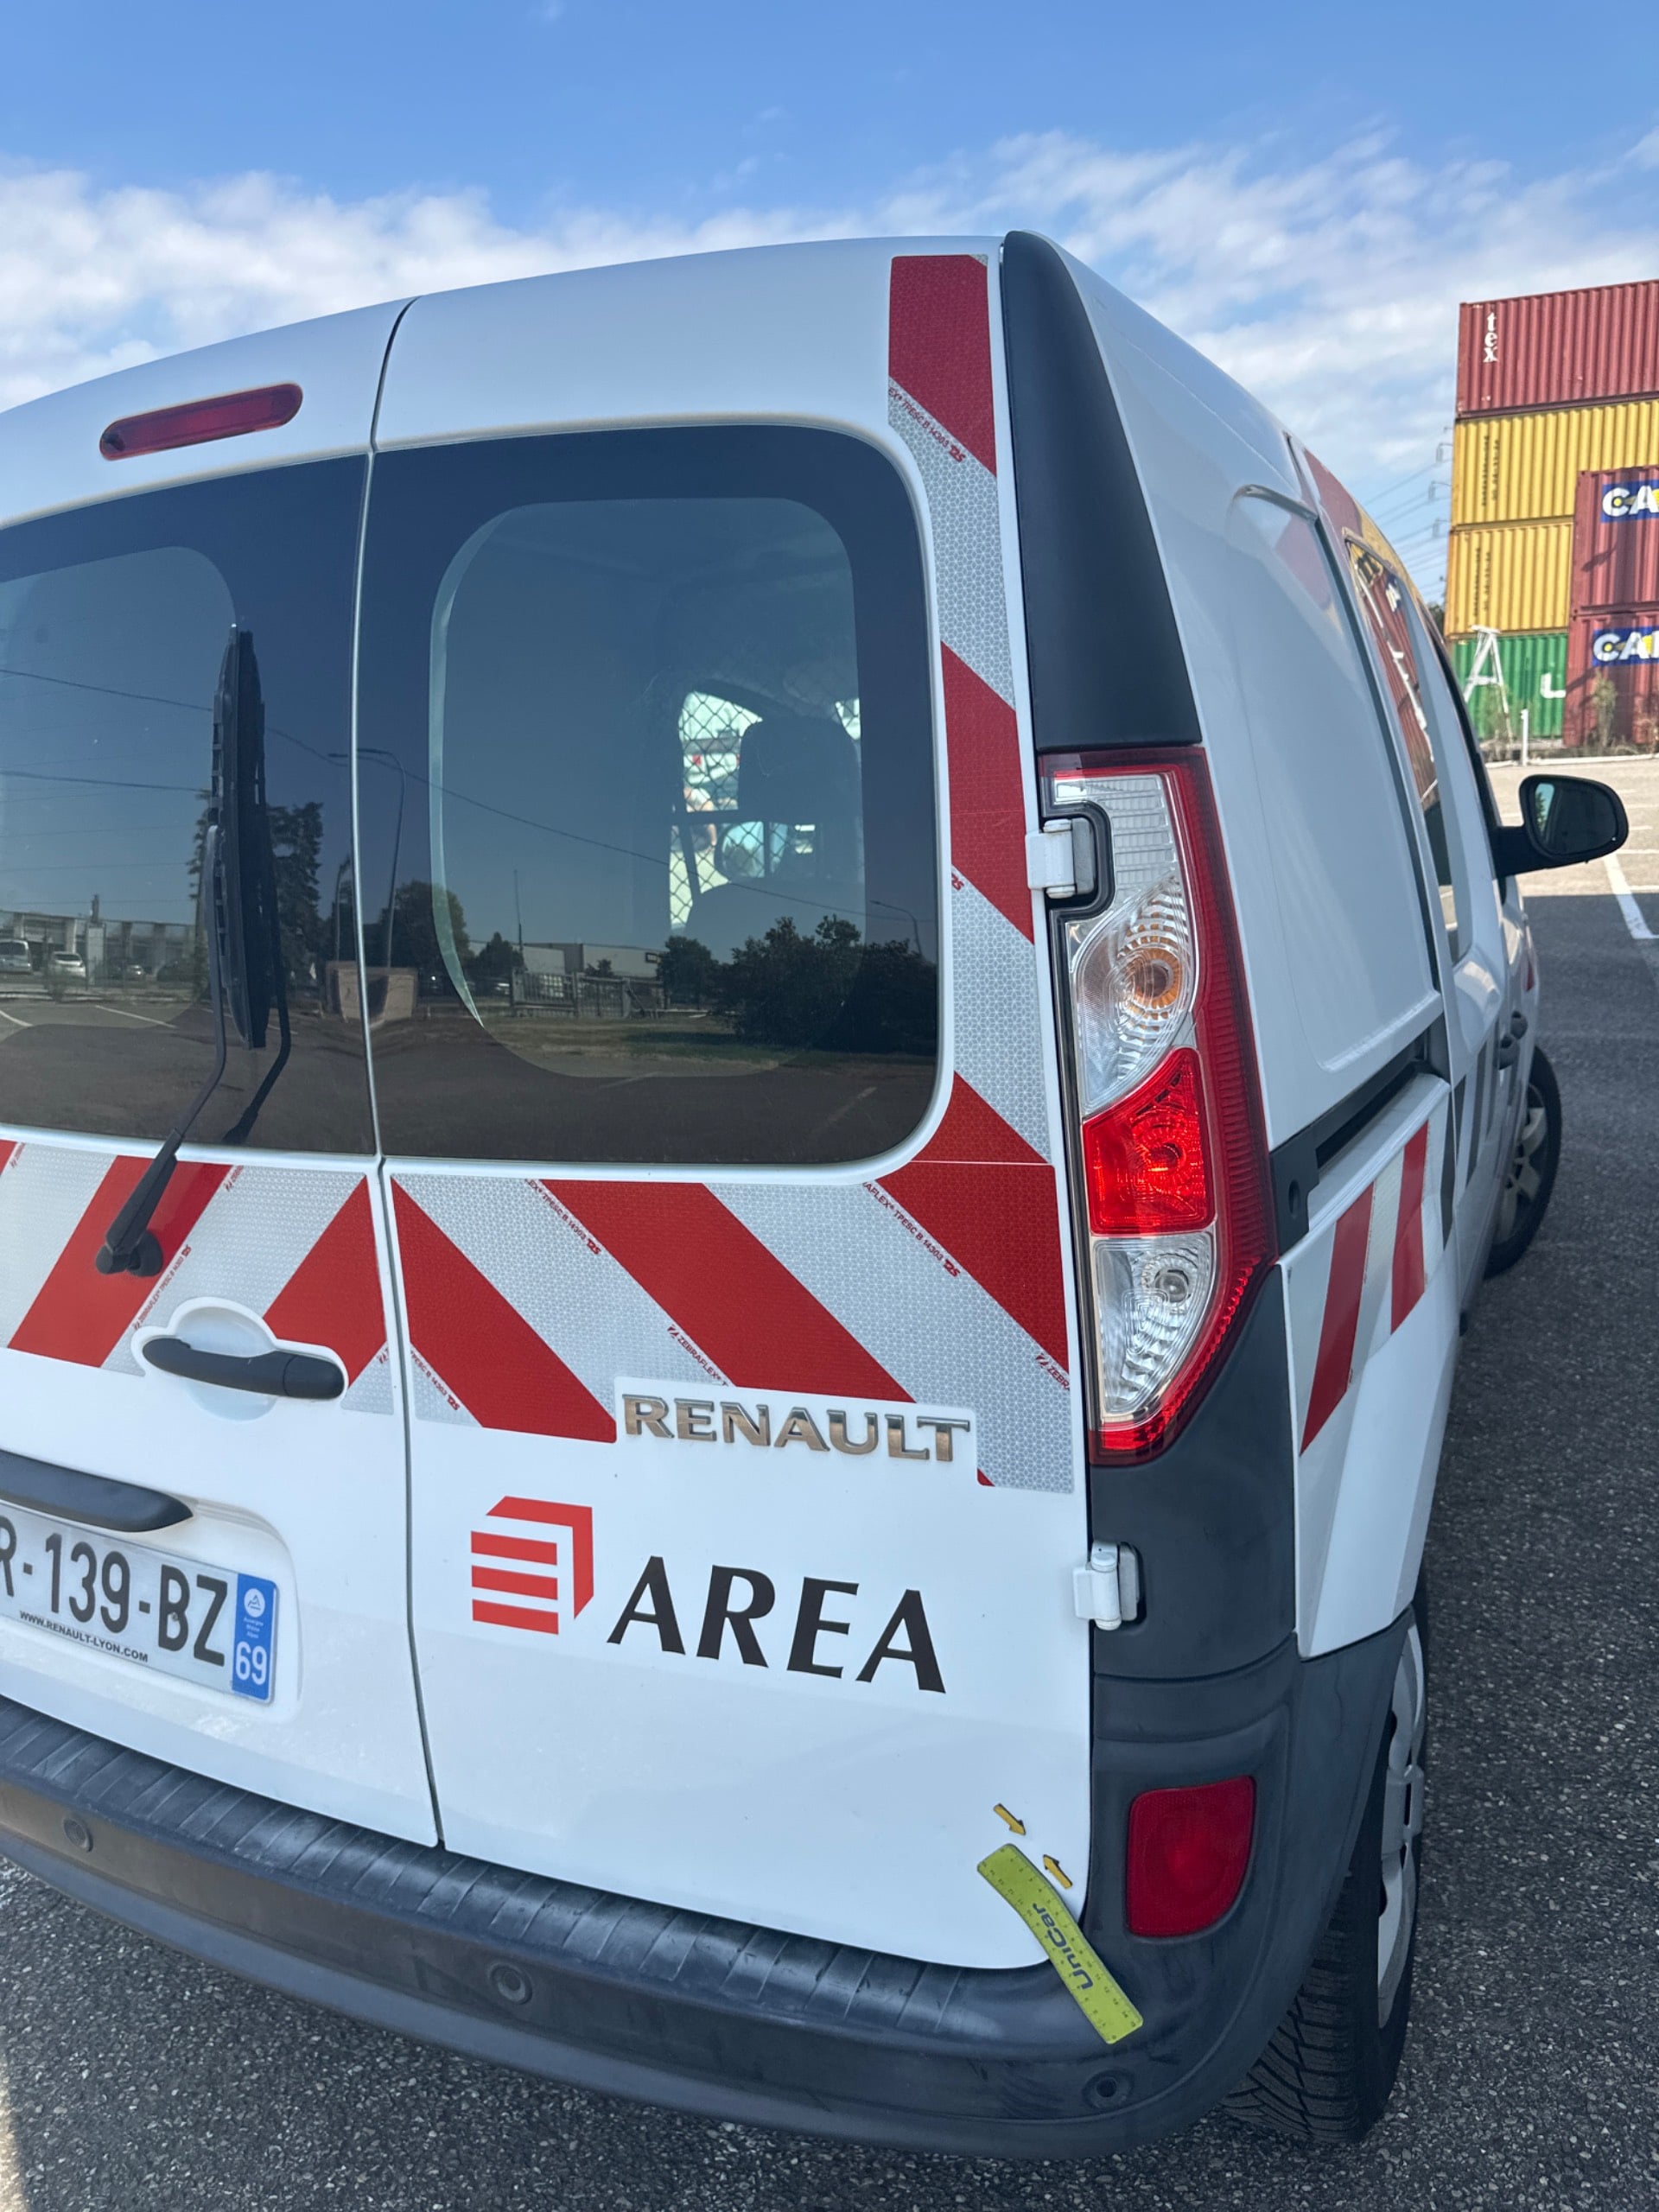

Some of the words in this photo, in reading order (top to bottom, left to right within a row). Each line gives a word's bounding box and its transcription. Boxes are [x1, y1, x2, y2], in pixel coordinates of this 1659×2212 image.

[1483, 312, 1498, 363] tex
[893, 1210, 917, 1234] TPESC
[923, 1239, 944, 1261] 14303
[1046, 1365, 1070, 1390] ZEBR
[622, 1394, 970, 1463] RENAULT
[19, 1610, 149, 1663] WWW.RENAULT-LYON.COM
[607, 1554, 946, 1694] AREA
[235, 1641, 267, 1685] 69
[1033, 1903, 1094, 1989] UniCar
